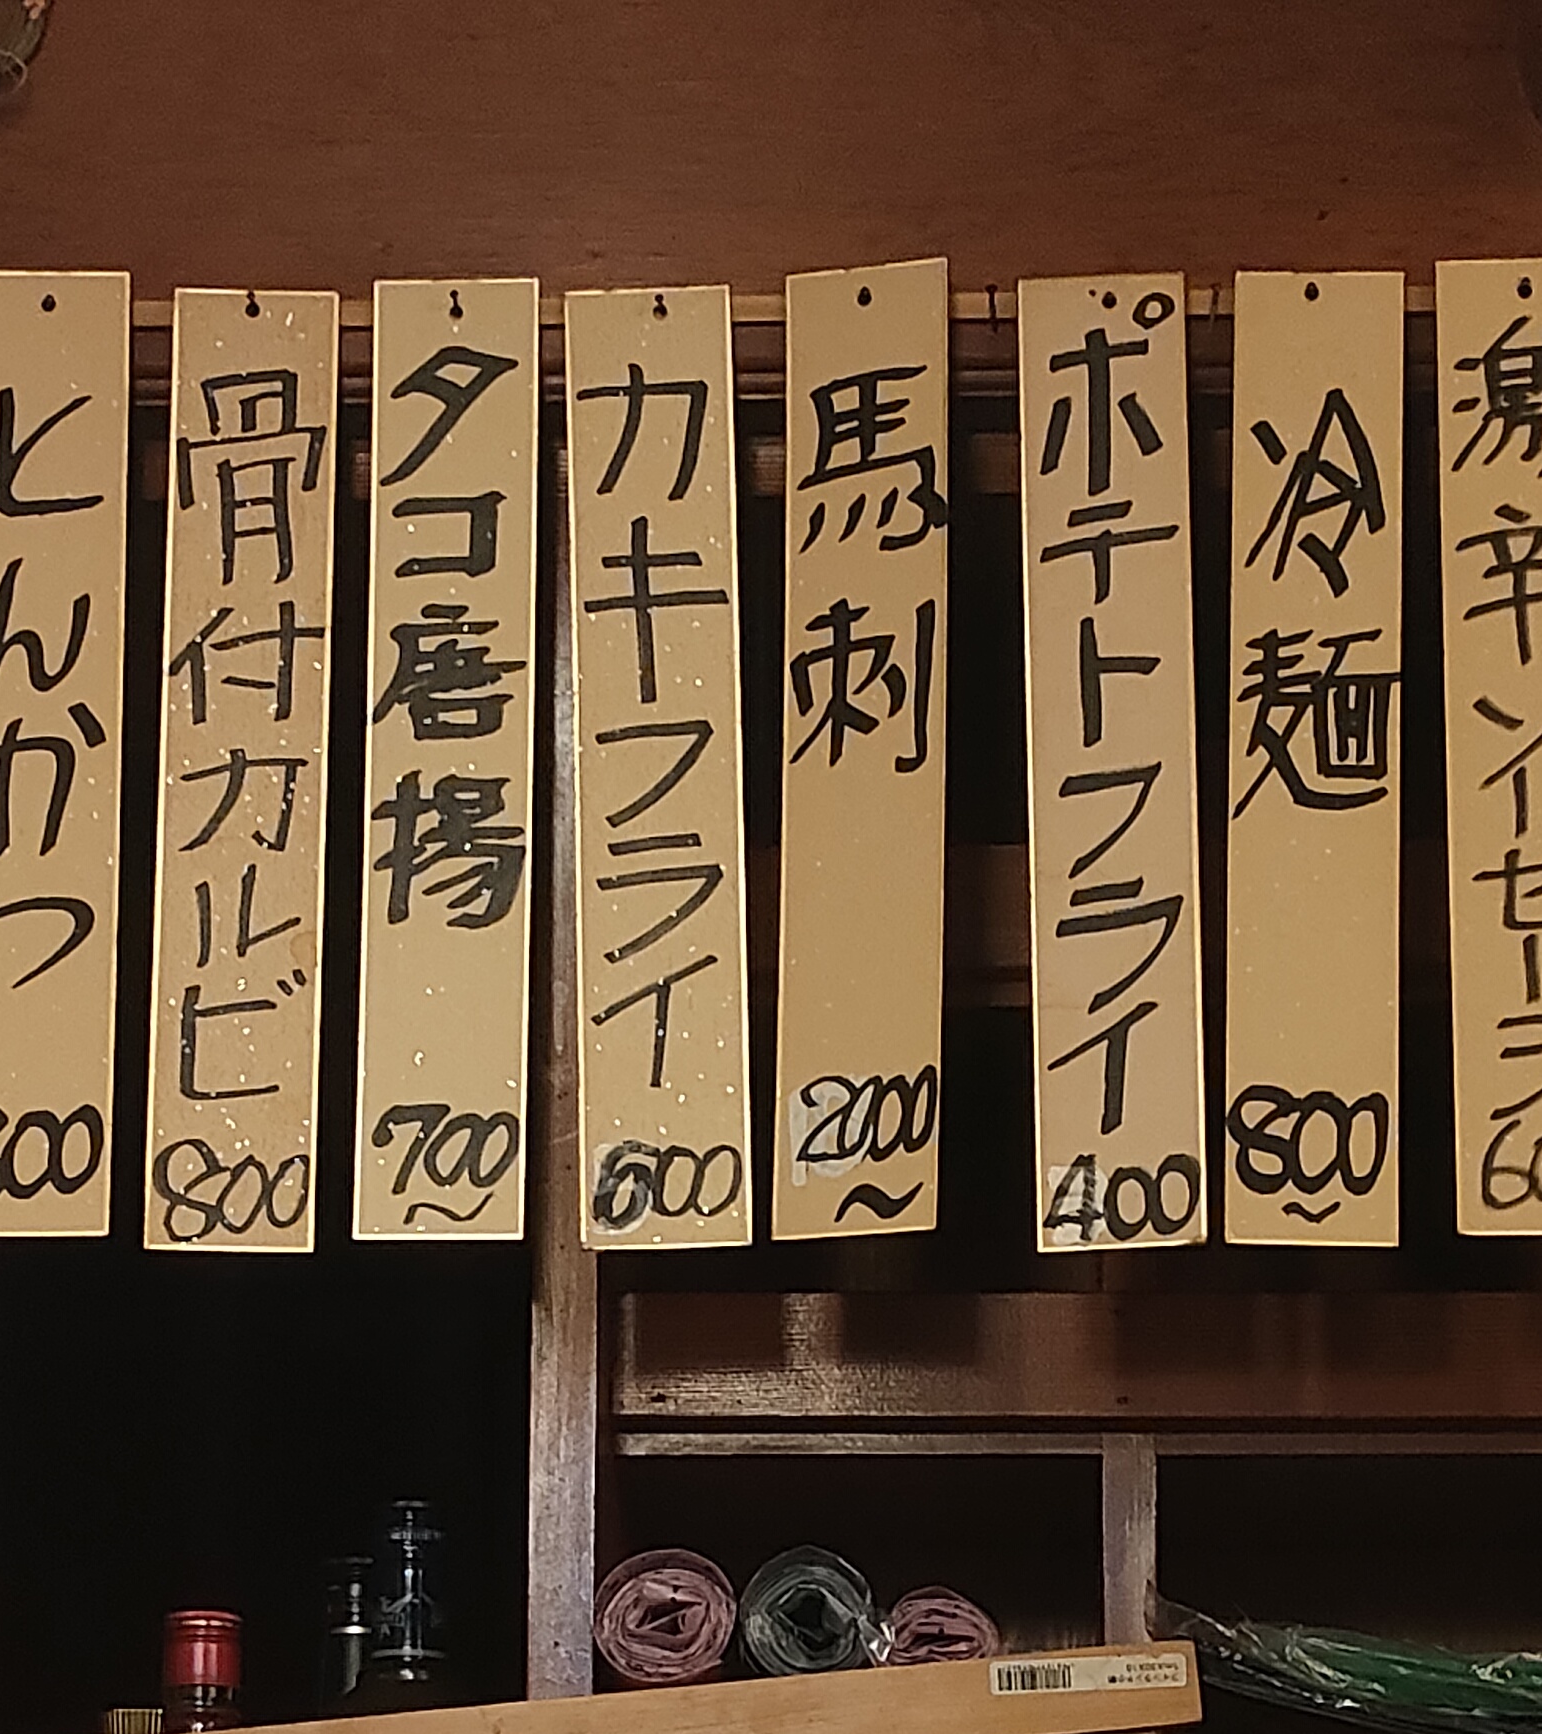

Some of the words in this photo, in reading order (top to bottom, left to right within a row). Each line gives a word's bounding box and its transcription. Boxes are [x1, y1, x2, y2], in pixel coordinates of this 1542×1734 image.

[168, 369, 327, 1100] 骨付カルビ
[371, 345, 528, 929] タコ唐揚
[576, 363, 730, 1089] カキフライ
[787, 365, 947, 773] 馬刺
[1039, 291, 1181, 1136] ポテトフライ
[153, 1138, 311, 1241] 800
[592, 1141, 742, 1233] 600
[1044, 1155, 1200, 1242] 400
